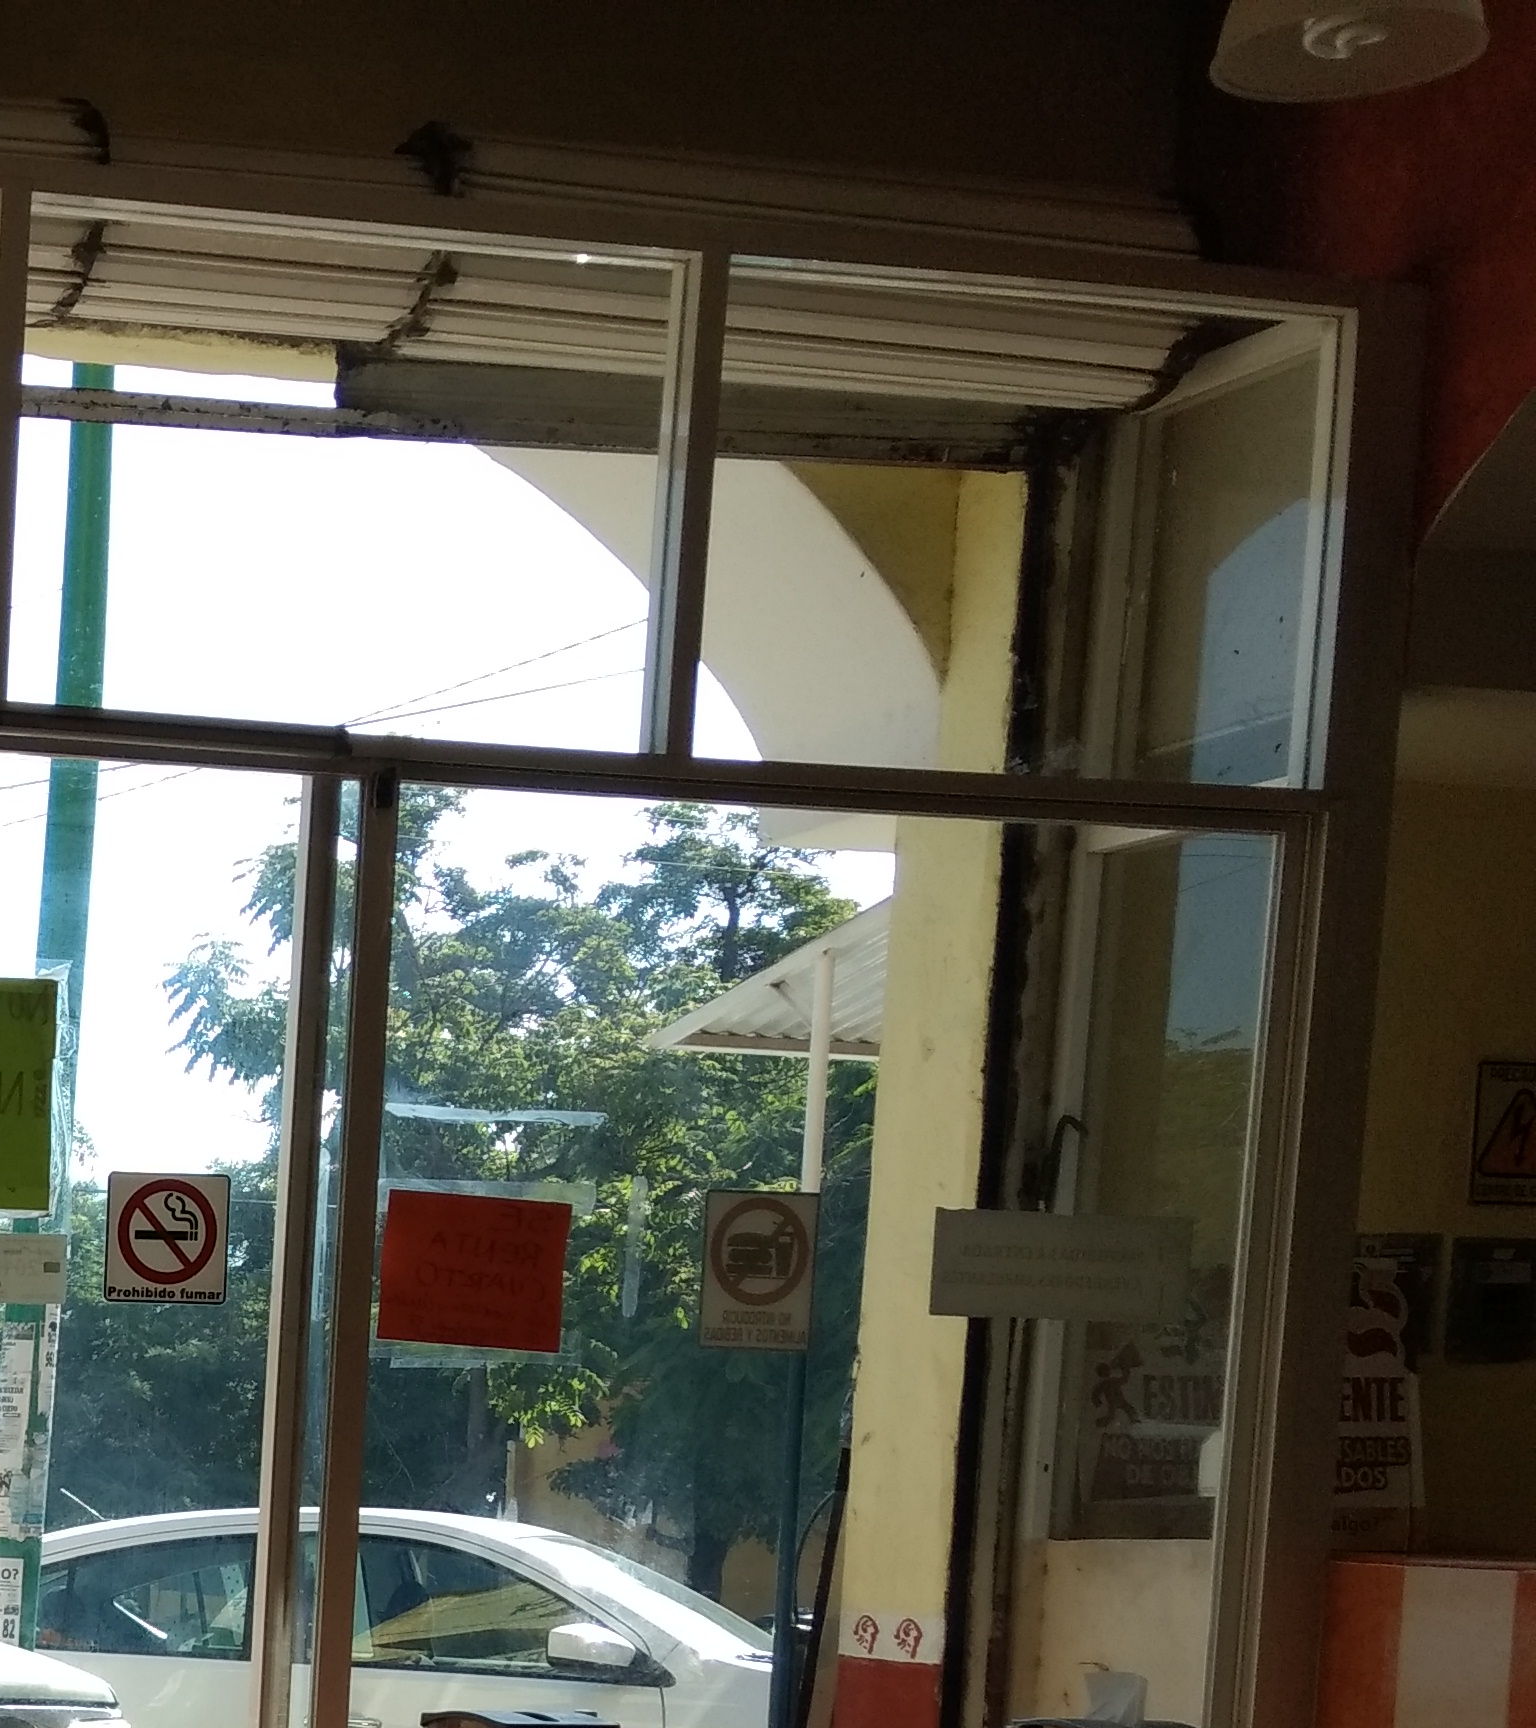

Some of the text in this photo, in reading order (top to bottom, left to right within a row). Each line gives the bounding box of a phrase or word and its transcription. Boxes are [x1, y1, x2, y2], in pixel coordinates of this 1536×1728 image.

[108, 1285, 223, 1301] Prohibido fumar
[1338, 1375, 1407, 1423] ENTE
